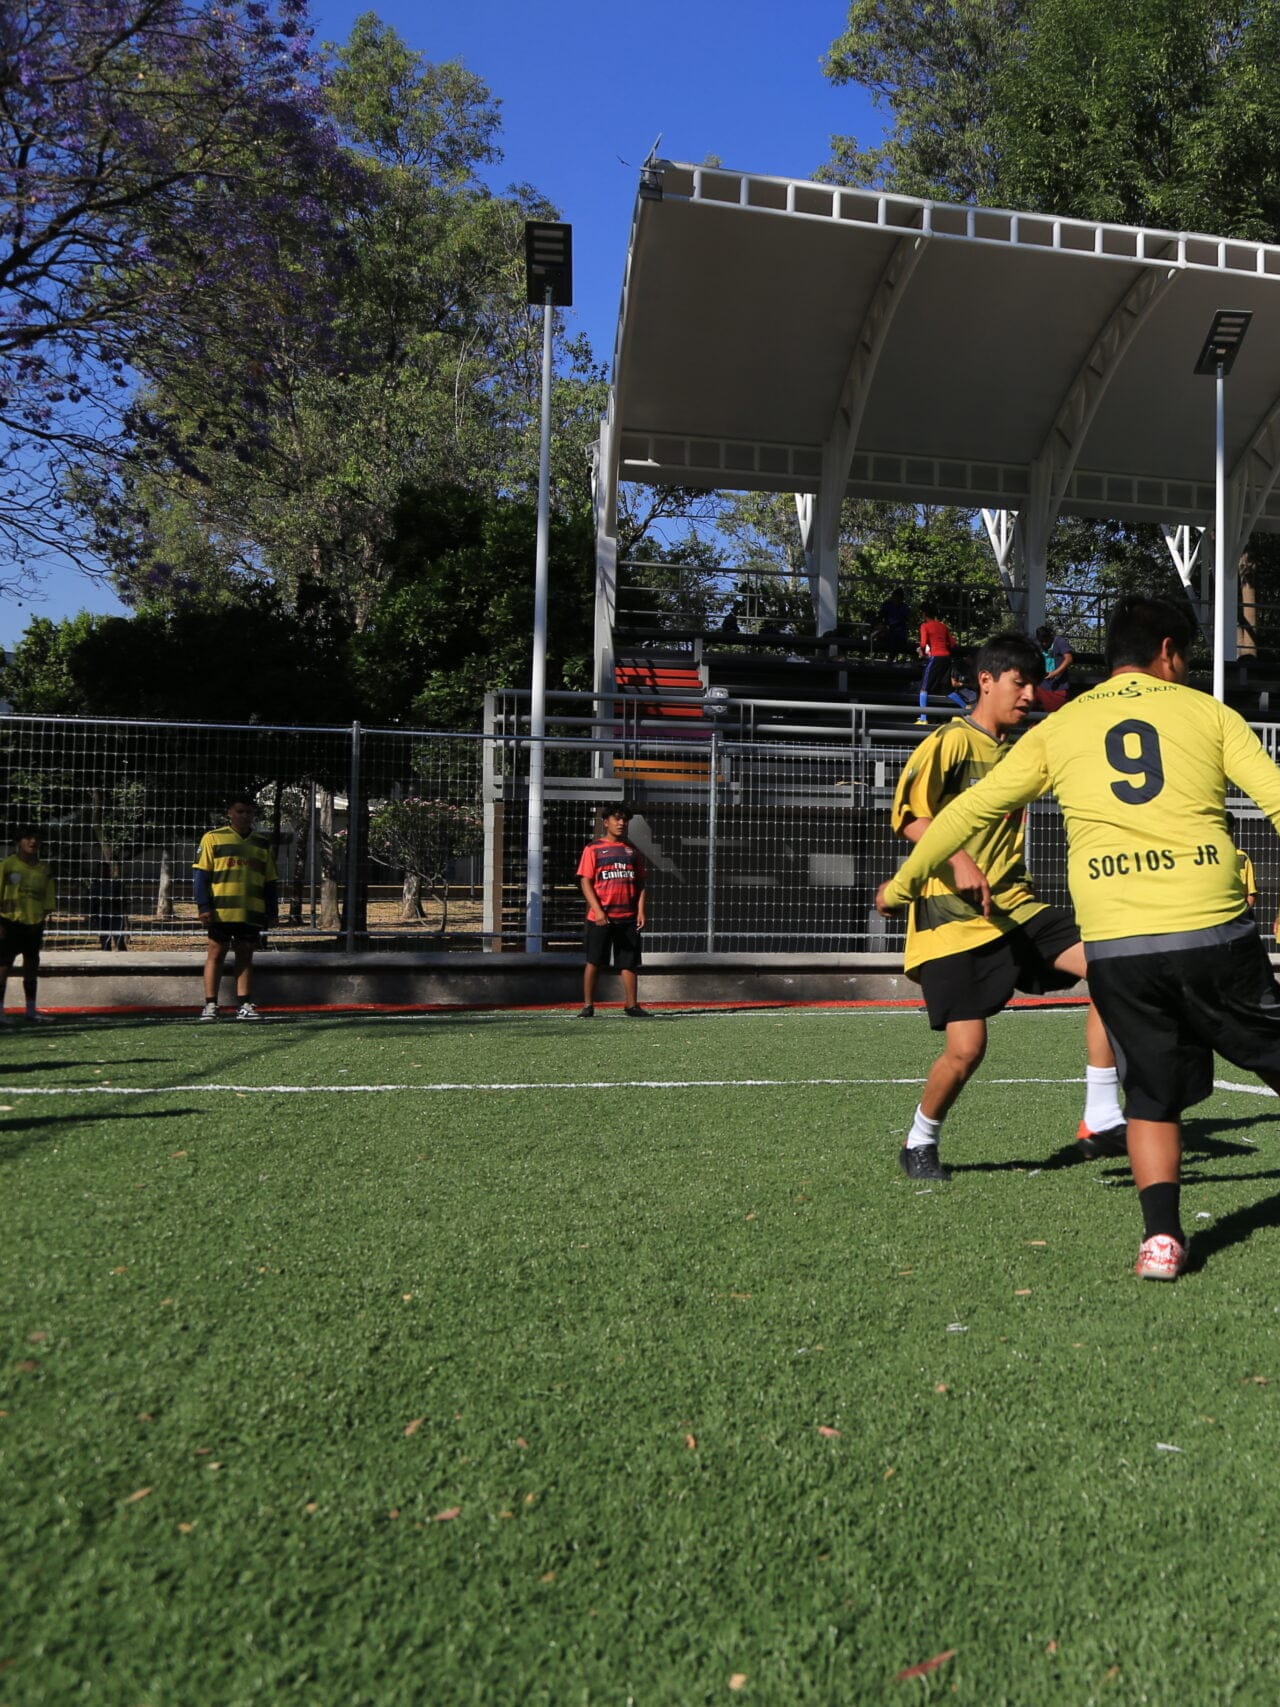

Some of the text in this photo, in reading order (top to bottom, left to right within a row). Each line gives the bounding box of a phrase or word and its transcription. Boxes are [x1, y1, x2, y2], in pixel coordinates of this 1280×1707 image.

[1145, 685, 1178, 694] SKIN
[1104, 718, 1165, 806] 9
[614, 862, 626, 870] Fly
[1088, 844, 1221, 881] SOCIOS JR
[602, 869, 635, 880] Emirate
